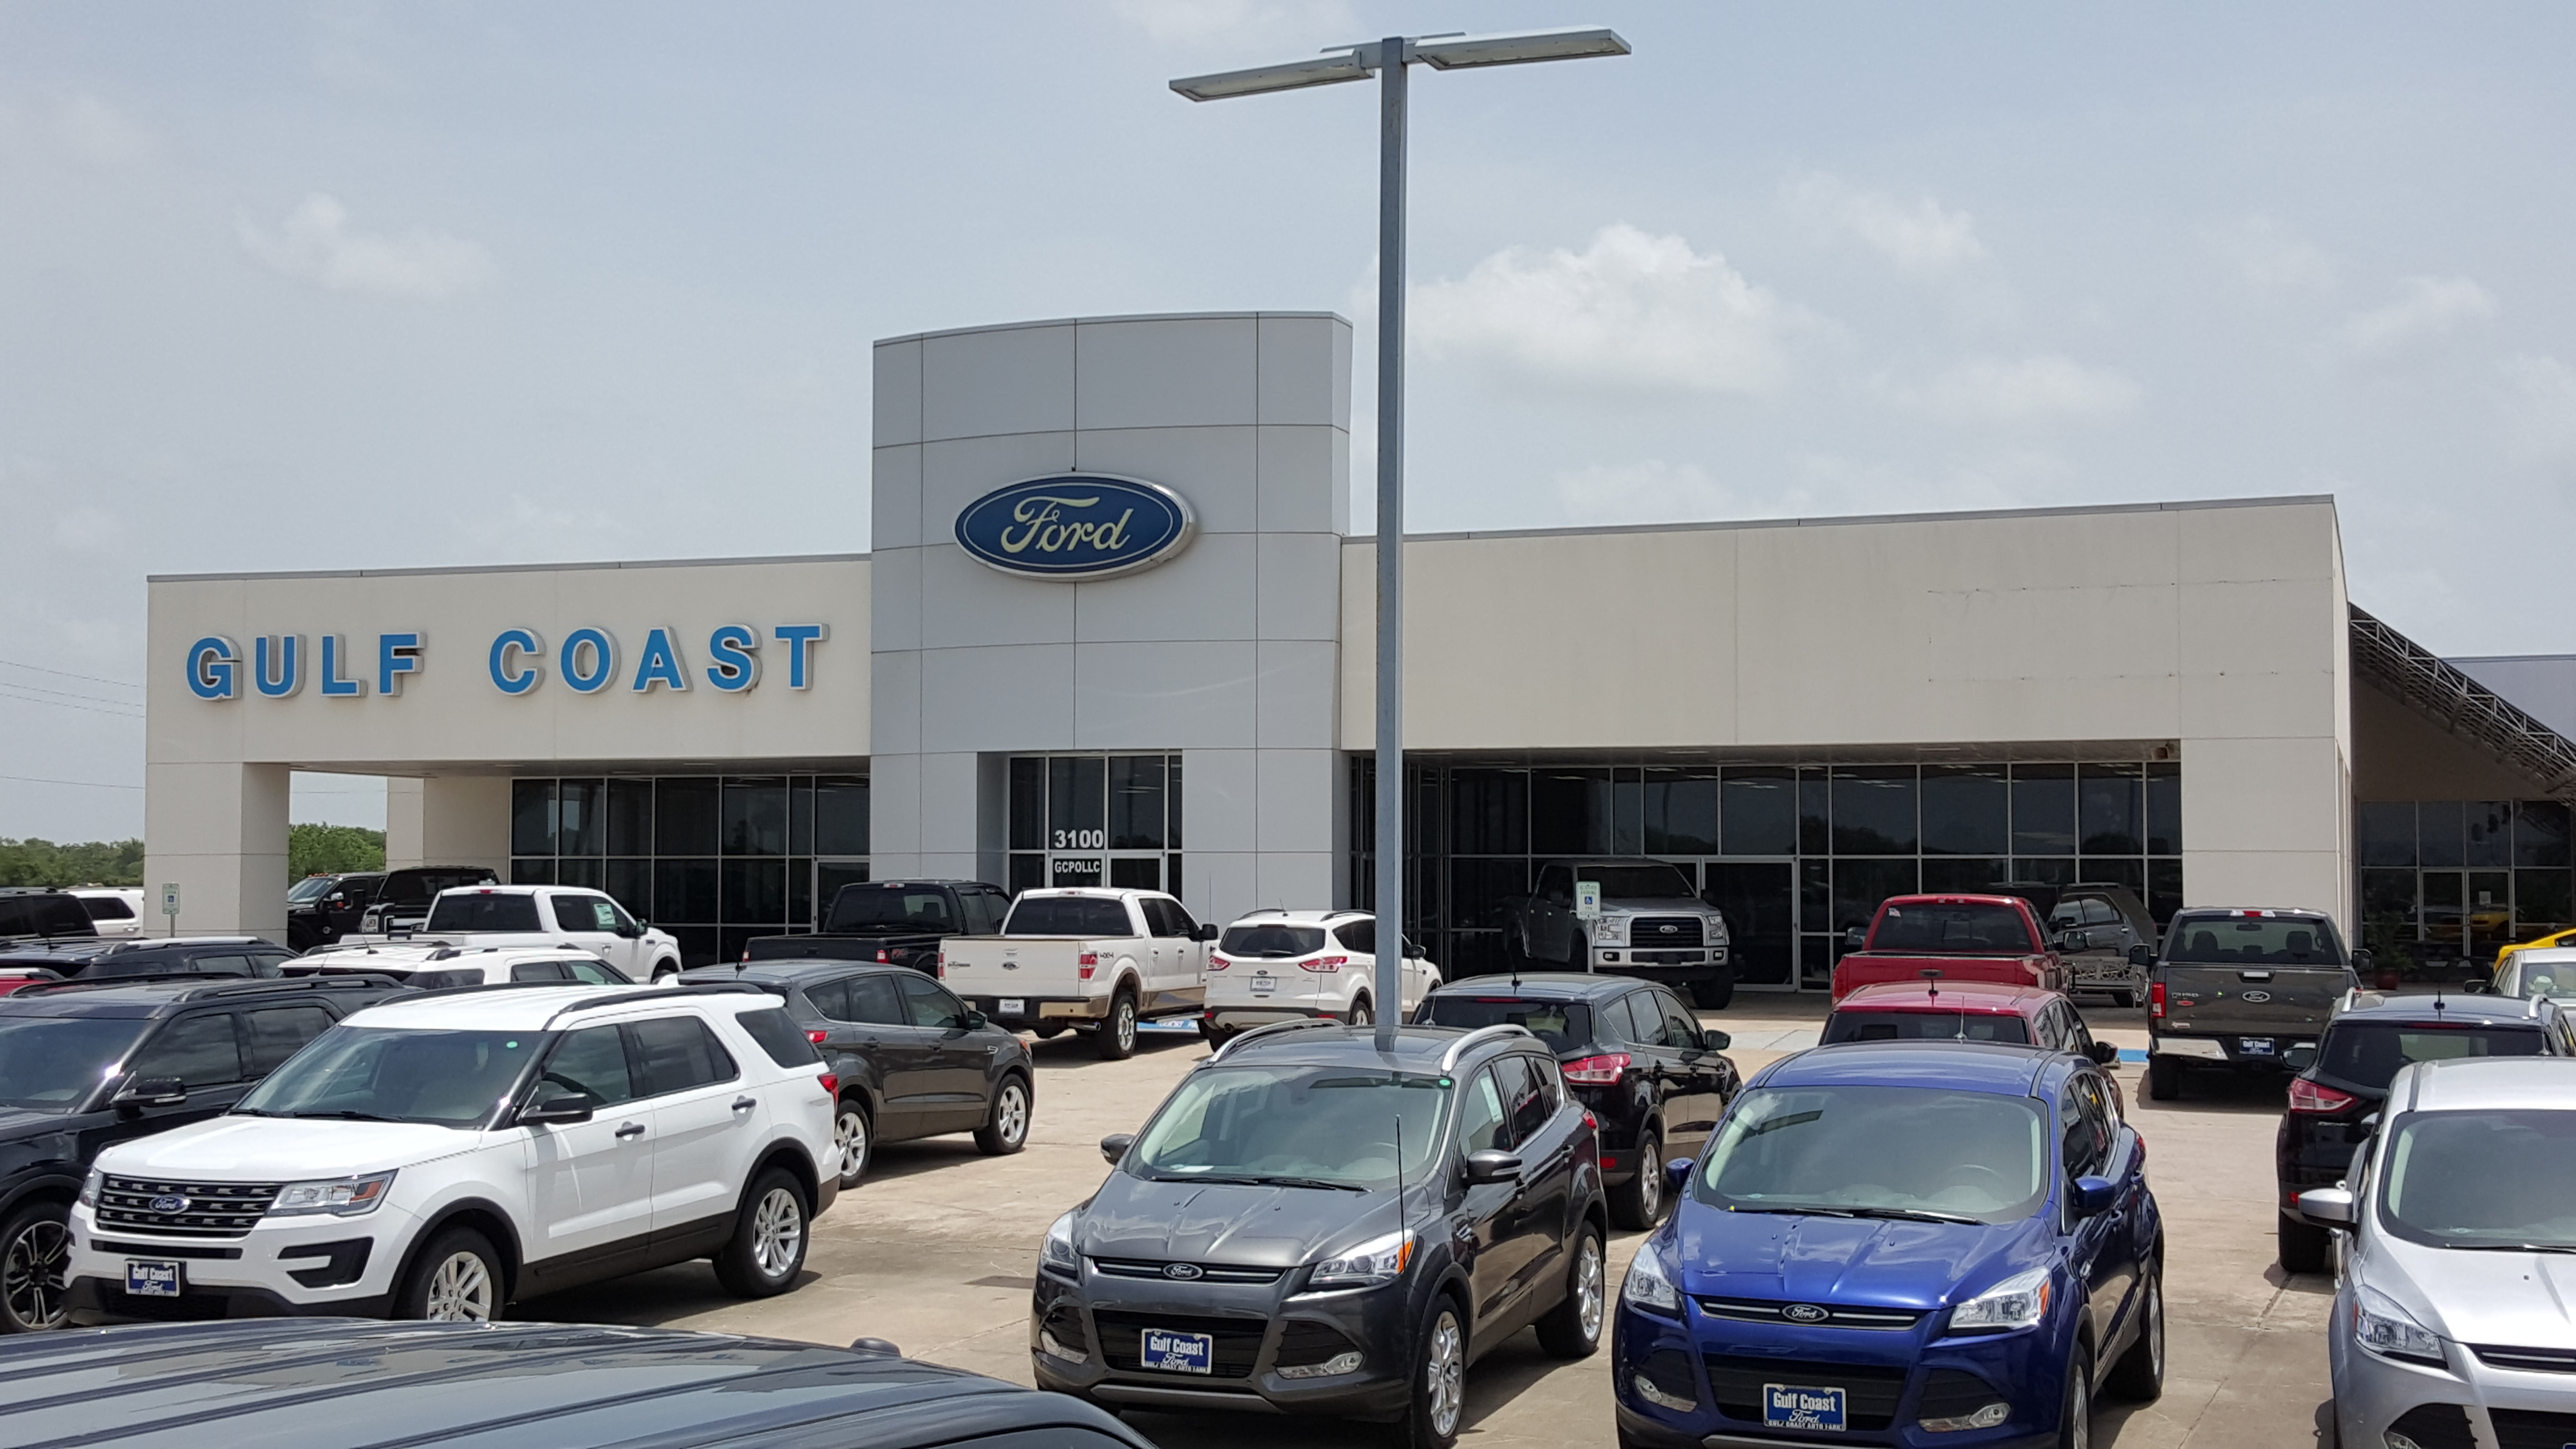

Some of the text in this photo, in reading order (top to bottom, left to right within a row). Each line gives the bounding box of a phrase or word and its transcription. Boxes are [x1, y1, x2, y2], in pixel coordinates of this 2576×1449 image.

[1001, 496, 1134, 553] Ford
[186, 623, 830, 701] GULF COAST
[1055, 829, 1104, 848] 3100
[1054, 861, 1100, 873] GCPOLLC
[1792, 1306, 1817, 1319] Ford
[1150, 1336, 1204, 1355] Gulf Coast
[1162, 1352, 1190, 1366] Ford
[1773, 1392, 1836, 1412] Gulf Coast
[1789, 1409, 1820, 1423] Ford
